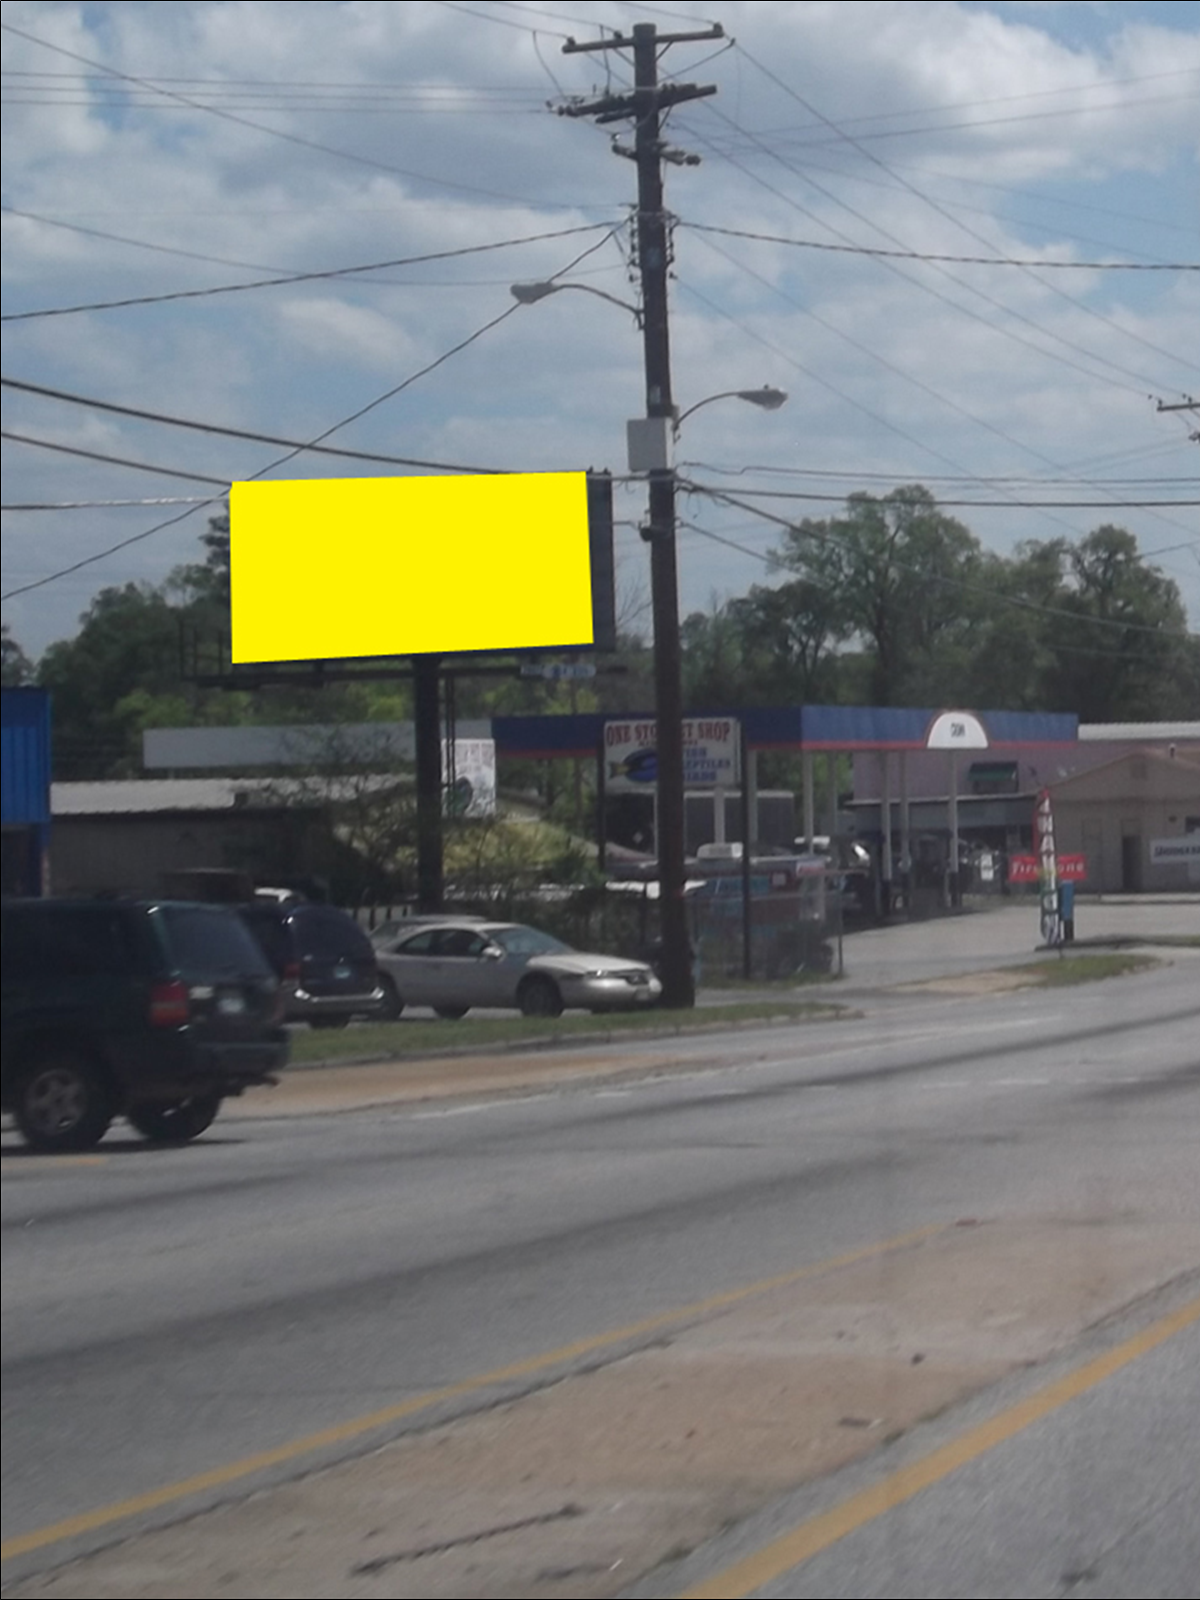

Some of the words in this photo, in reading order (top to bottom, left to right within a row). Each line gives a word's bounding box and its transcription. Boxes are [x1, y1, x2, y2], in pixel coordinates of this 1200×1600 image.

[606, 724, 631, 746] ONE
[634, 723, 658, 741] STO
[698, 721, 731, 742] SHOP
[685, 747, 707, 758] ISH
[684, 758, 731, 769] EPTILES
[1011, 861, 1085, 875] Fireone
